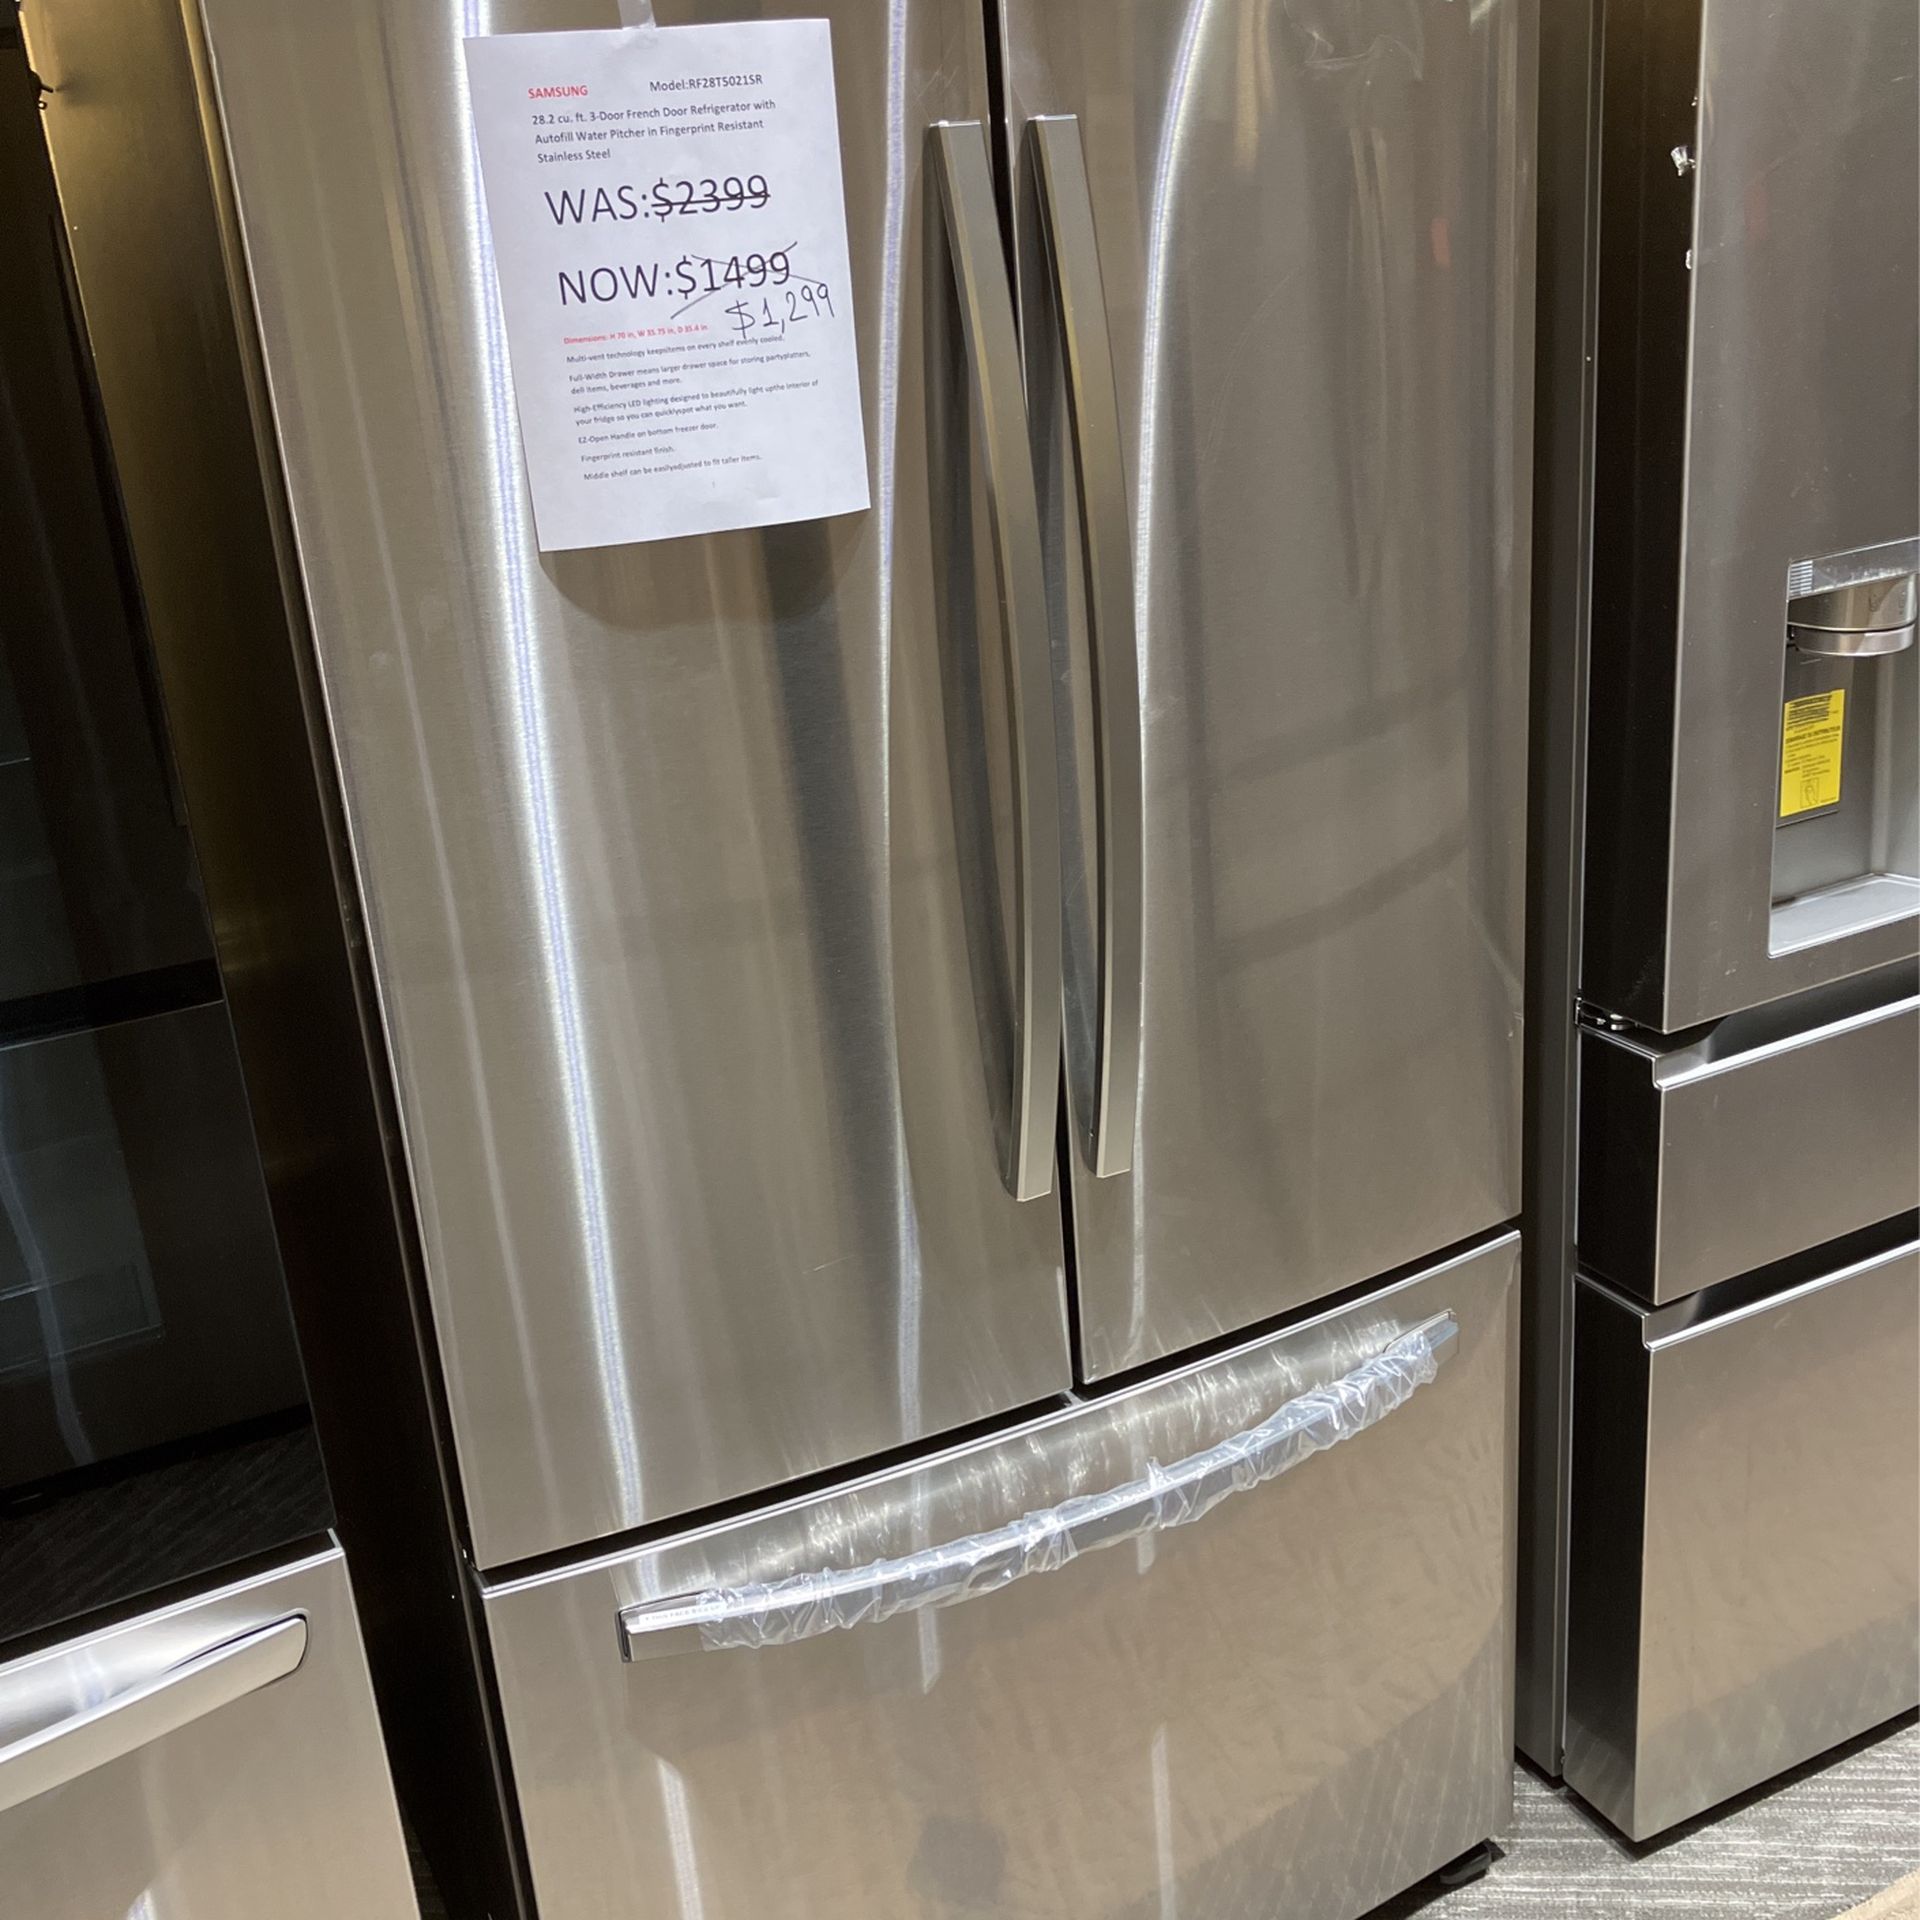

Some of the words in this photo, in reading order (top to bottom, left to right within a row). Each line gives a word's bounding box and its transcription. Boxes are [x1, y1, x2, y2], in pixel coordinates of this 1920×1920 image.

[528, 85, 588, 99] SAMSUNG
[649, 74, 763, 92] Model:RF28T5021SR
[531, 114, 556, 125] 28.2
[557, 115, 573, 124] cu.
[575, 112, 588, 122] ft.
[590, 111, 624, 121] 3-Door
[626, 108, 660, 120] French
[663, 107, 688, 117] Door
[690, 101, 751, 116] Refrigerator
[753, 99, 776, 109] with
[535, 131, 574, 144] Autofill
[575, 131, 607, 141] Water
[610, 127, 645, 139] Pitcher
[647, 127, 657, 136] in
[660, 123, 715, 137] Fingerprint
[718, 119, 764, 131] Resistant
[537, 150, 583, 163] Stainless
[585, 148, 611, 160] Steel
[544, 174, 770, 225] WAS:$2399
[558, 252, 790, 305] NOW:$1499
[725, 284, 835, 339] $1,299
[564, 334, 607, 344] Dimensions:
[609, 332, 615, 340] H
[617, 331, 626, 339] 70
[637, 329, 645, 337] W
[566, 352, 605, 363] Multi-vent
[606, 349, 645, 359] technology
[647, 345, 685, 355] keepsitems
[698, 342, 716, 350] every
[718, 339, 735, 348] shelf
[736, 337, 758, 346] evenly
[760, 334, 785, 343] cooled.
[569, 372, 607, 382] Full-Width
[609, 369, 635, 378] Drawer
[636, 366, 659, 374] means
[661, 363, 681, 373] larger
[682, 361, 706, 370] drawer
[708, 358, 728, 368] space
[729, 356, 739, 365] for
[740, 354, 765, 363] storing
[571, 386, 585, 395] deli
[586, 383, 609, 393] items,
[610, 380, 646, 391] beverages
[648, 378, 660, 386] and
[662, 377, 682, 385] more.
[573, 402, 627, 414] High-Efficiency
[628, 399, 641, 408] LED
[643, 397, 668, 407] lighting
[670, 393, 700, 403] designed
[701, 392, 709, 400] to
[711, 387, 747, 399] beautifully
[748, 385, 764, 395] light
[786, 381, 810, 390] interior
[812, 379, 818, 387] of
[576, 418, 592, 426] your
[594, 415, 615, 424] fridge
[627, 412, 639, 421] you
[655, 406, 693, 417] quicklyspot
[695, 404, 712, 412] what
[714, 403, 726, 411] you
[728, 401, 748, 409] want.
[578, 434, 609, 444] EZ-Open
[610, 431, 635, 440] Handle
[637, 430, 646, 438] on
[648, 427, 673, 436] bottom
[675, 424, 699, 432] freezer
[700, 422, 719, 430] door.
[581, 451, 621, 462] Fingerprint
[622, 448, 653, 458] resistant
[654, 446, 675, 454] finish.
[584, 472, 609, 481] Middle
[611, 469, 628, 477] shelf
[630, 468, 642, 476] can
[643, 466, 652, 474] be
[704, 459, 712, 467] to
[721, 456, 740, 465] taller
[741, 453, 763, 462] items.
